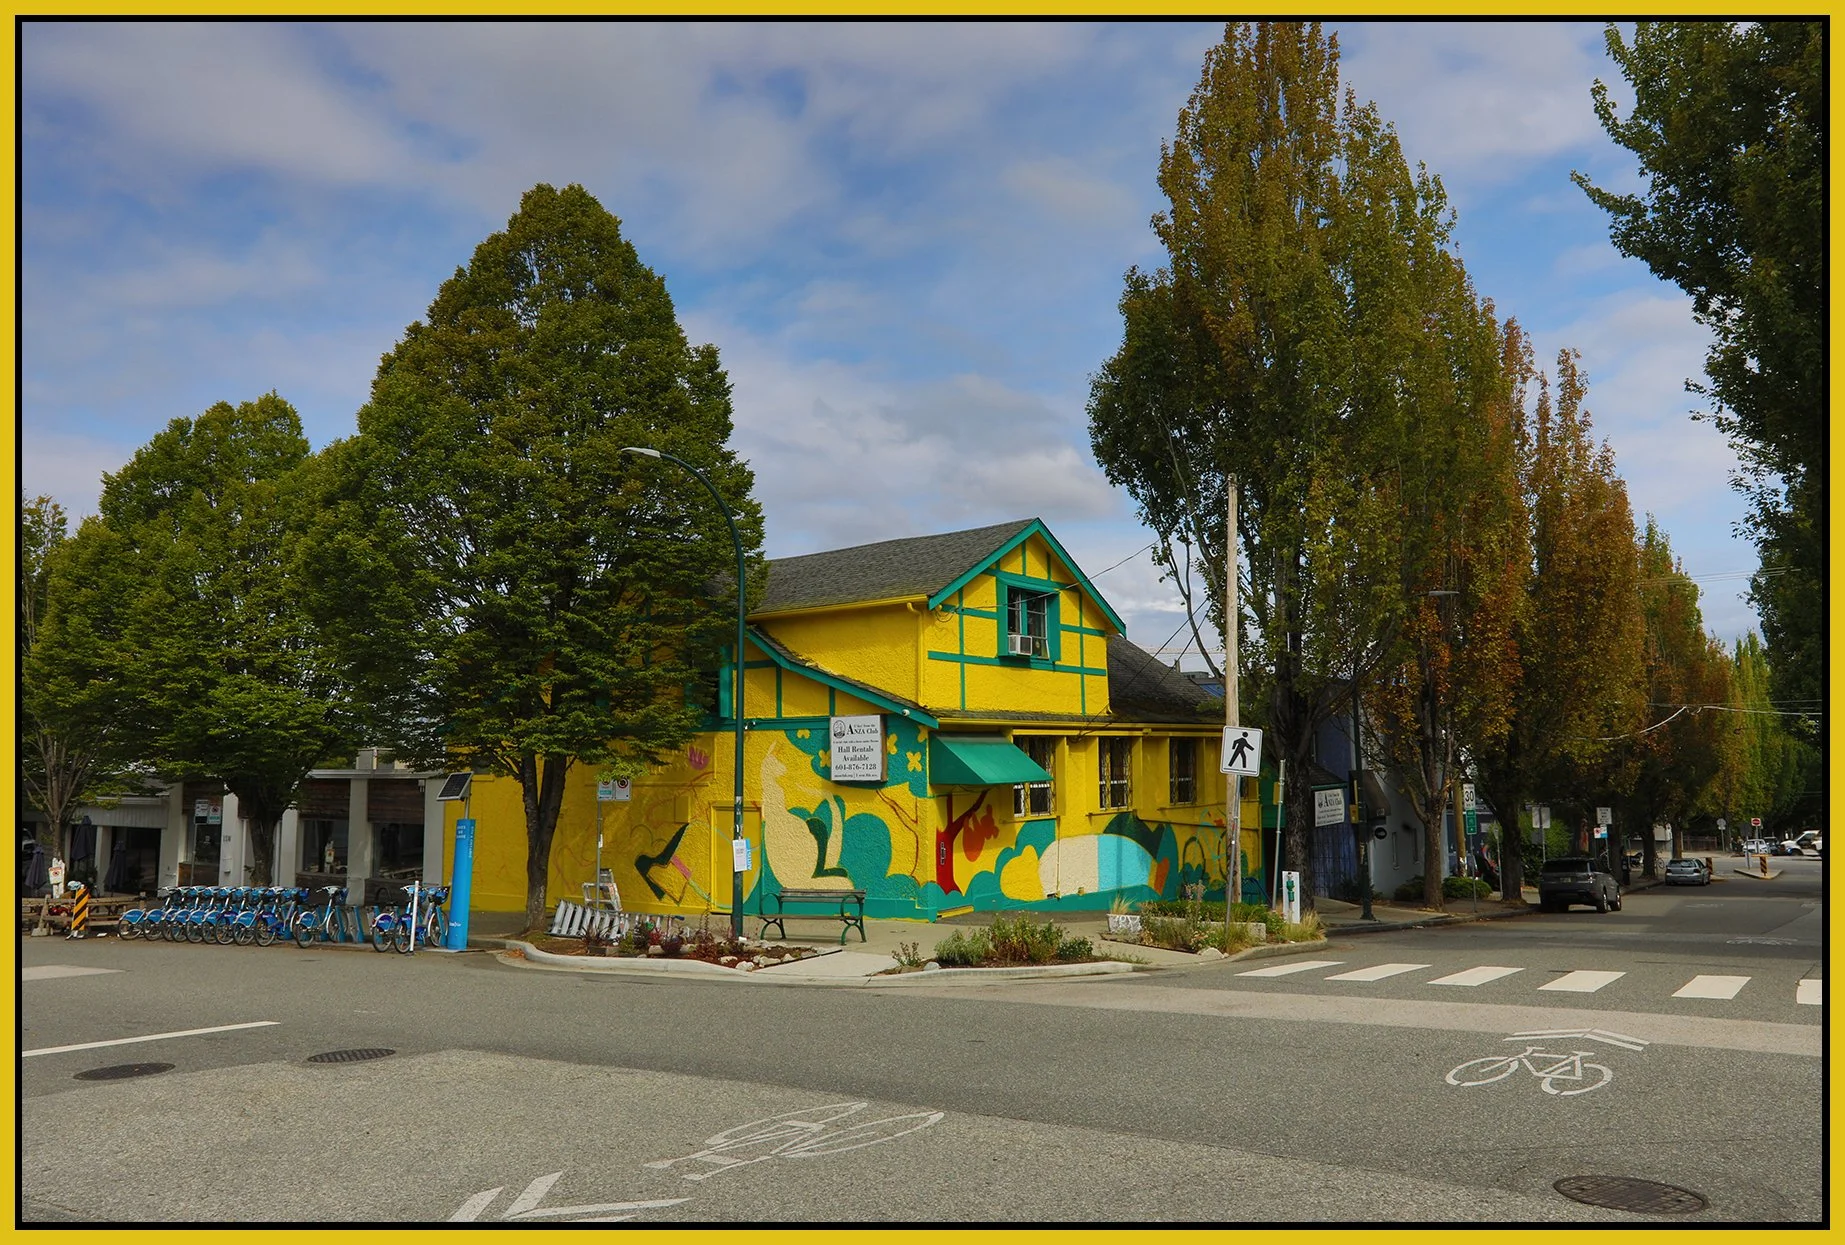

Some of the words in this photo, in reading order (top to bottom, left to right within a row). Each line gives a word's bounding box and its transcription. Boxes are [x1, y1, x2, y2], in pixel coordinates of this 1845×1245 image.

[847, 724, 866, 735] ANZA
[852, 745, 874, 753] Rentals
[843, 754, 870, 762] Available
[1465, 791, 1474, 801] 30
